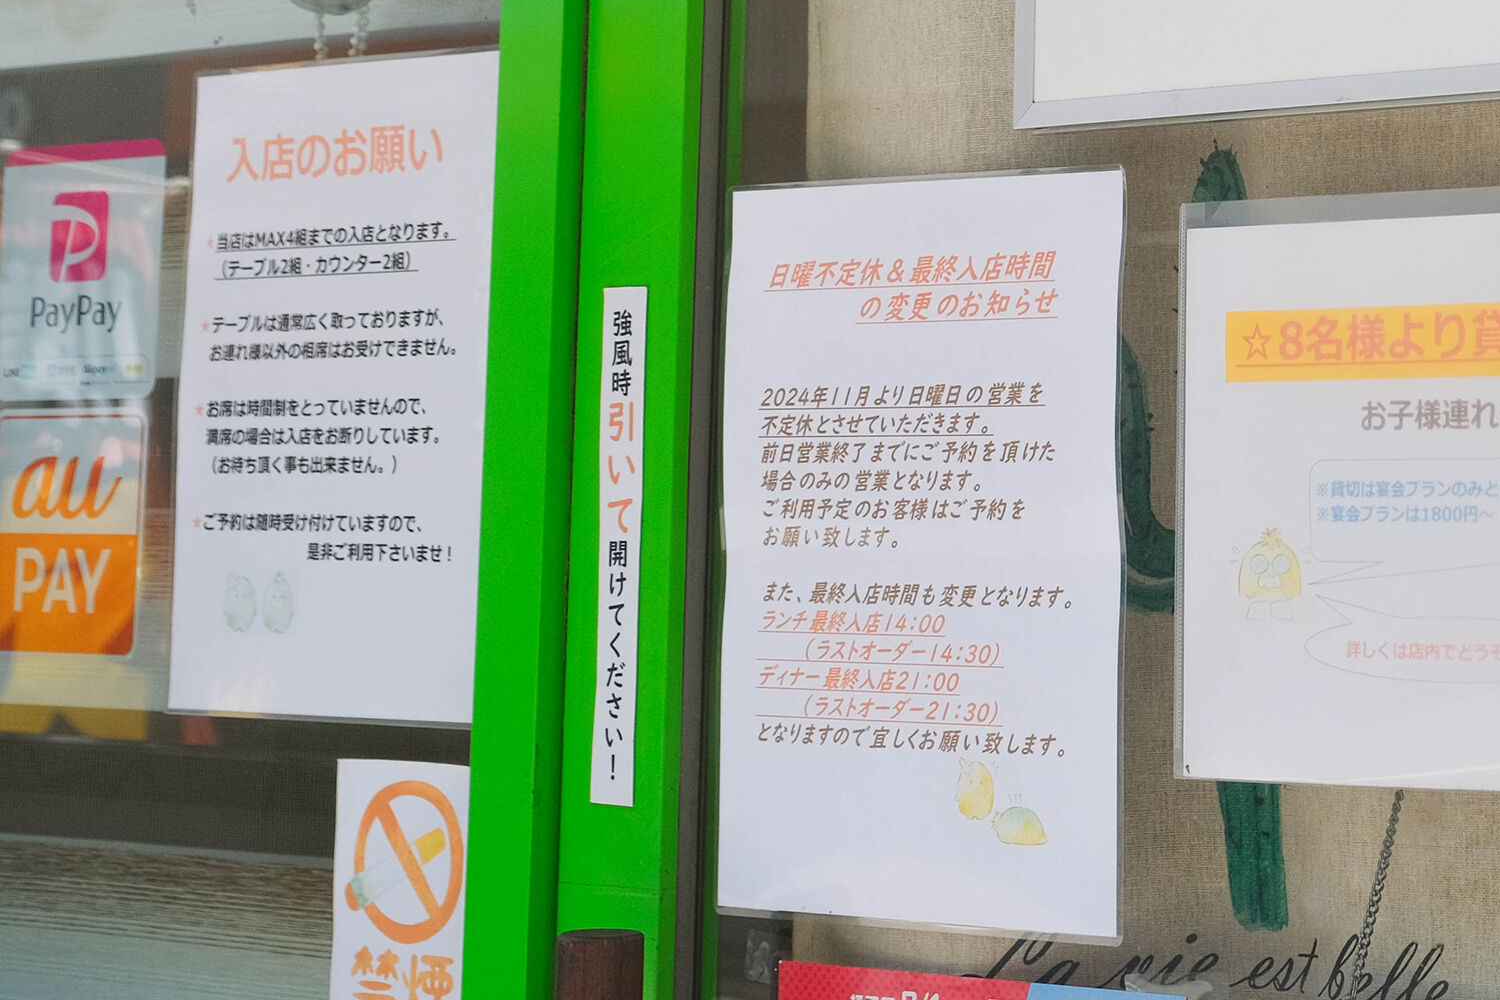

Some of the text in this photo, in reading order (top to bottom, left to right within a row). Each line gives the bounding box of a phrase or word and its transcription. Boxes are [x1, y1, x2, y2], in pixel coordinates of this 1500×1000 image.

[227, 124, 444, 182] 入店のお願い
[216, 220, 451, 251] 当店はMAX4組までの入店となります。
[769, 250, 1056, 289] 日曜不定休＆最終入店時間
[30, 294, 122, 334] PayPay
[859, 289, 1058, 321] の変更のお知らせ
[212, 308, 444, 333] テーブルは通常広く取っておりますが、
[206, 397, 427, 417] お席は時間制をとっていませんので、
[760, 382, 1044, 408] 2024年11月より日曜日の営業を
[206, 426, 442, 447] 満席の場合は入店をお断りしています。
[761, 412, 990, 437] 不定休とさせていただきます。
[761, 441, 1056, 464] 前日営業終了までにご予約を頂けた
[11, 454, 122, 520] au
[761, 469, 981, 492] 場合のみの営業となります。
[203, 513, 423, 533] ご予約は随時受け付けていますので、
[762, 498, 1025, 521] ご利用予定のお客様はご予約を
[604, 311, 635, 780] 強風時引いて開けてください！
[763, 525, 898, 549] お願い致します。
[307, 543, 452, 563] 是非ご利用下さいませ！
[13, 548, 112, 614] PAY
[762, 581, 1072, 610] また、最終入店時間も変更となります。
[760, 610, 945, 633] ランチ最終入店14:00
[758, 664, 960, 692] ディナー最終入店21:00
[757, 723, 1066, 758] となりますので宜しくお願い致します。
[1230, 938, 1320, 995] est
